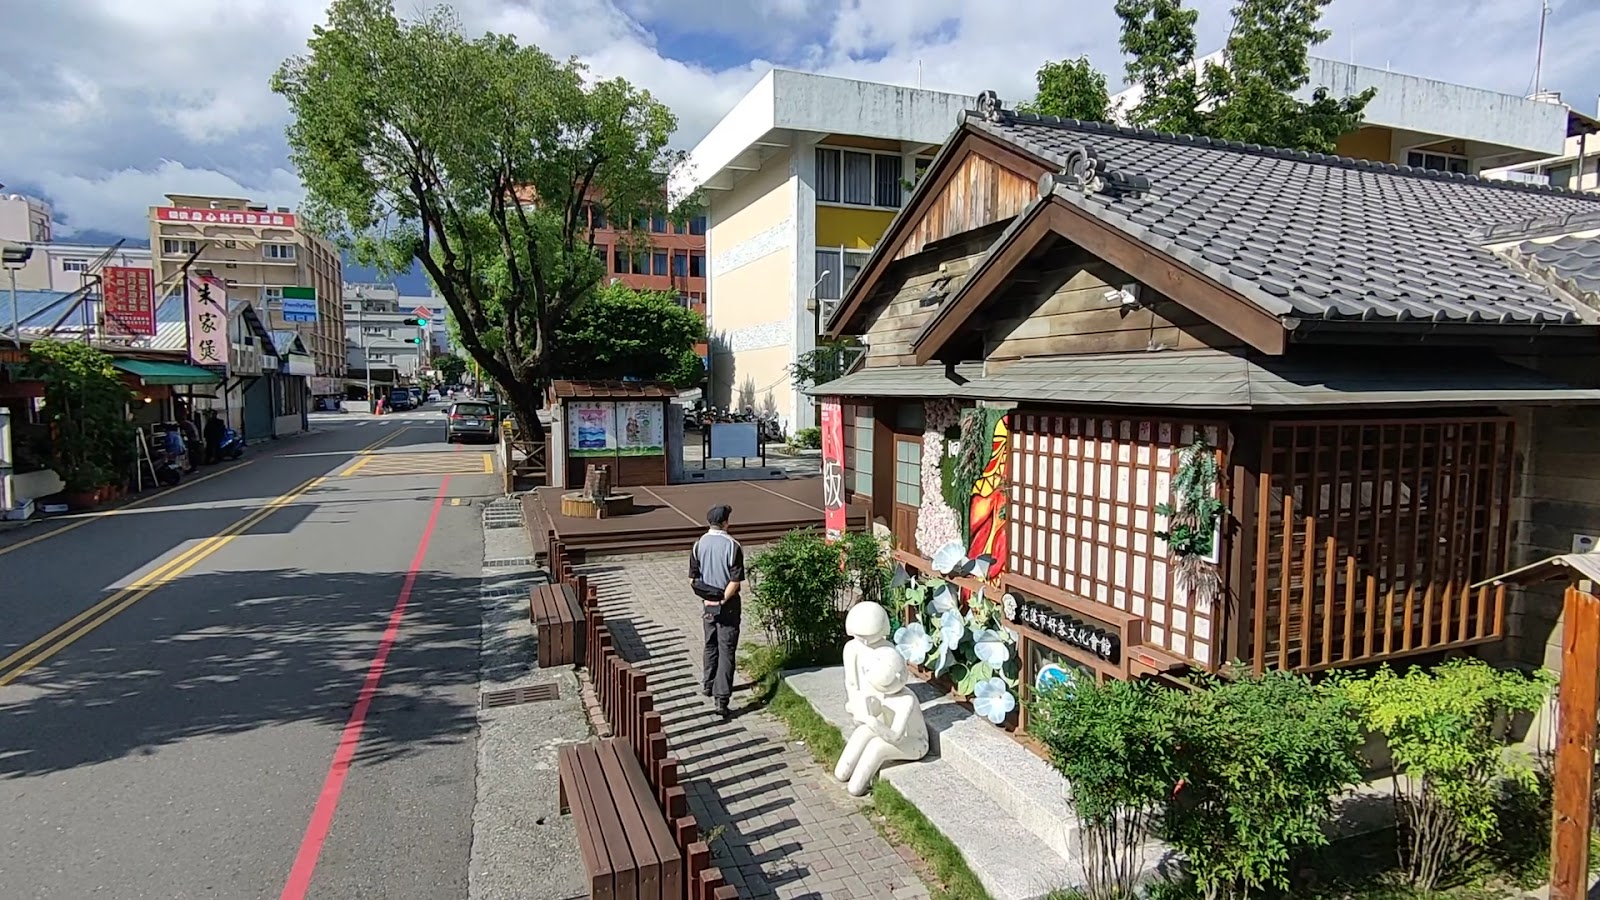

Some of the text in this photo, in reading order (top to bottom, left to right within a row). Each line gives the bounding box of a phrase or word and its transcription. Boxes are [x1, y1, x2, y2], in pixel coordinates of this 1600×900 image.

[197, 283, 220, 361] 朱家煲
[1020, 605, 1111, 656] 花蓮市好客文化會館
